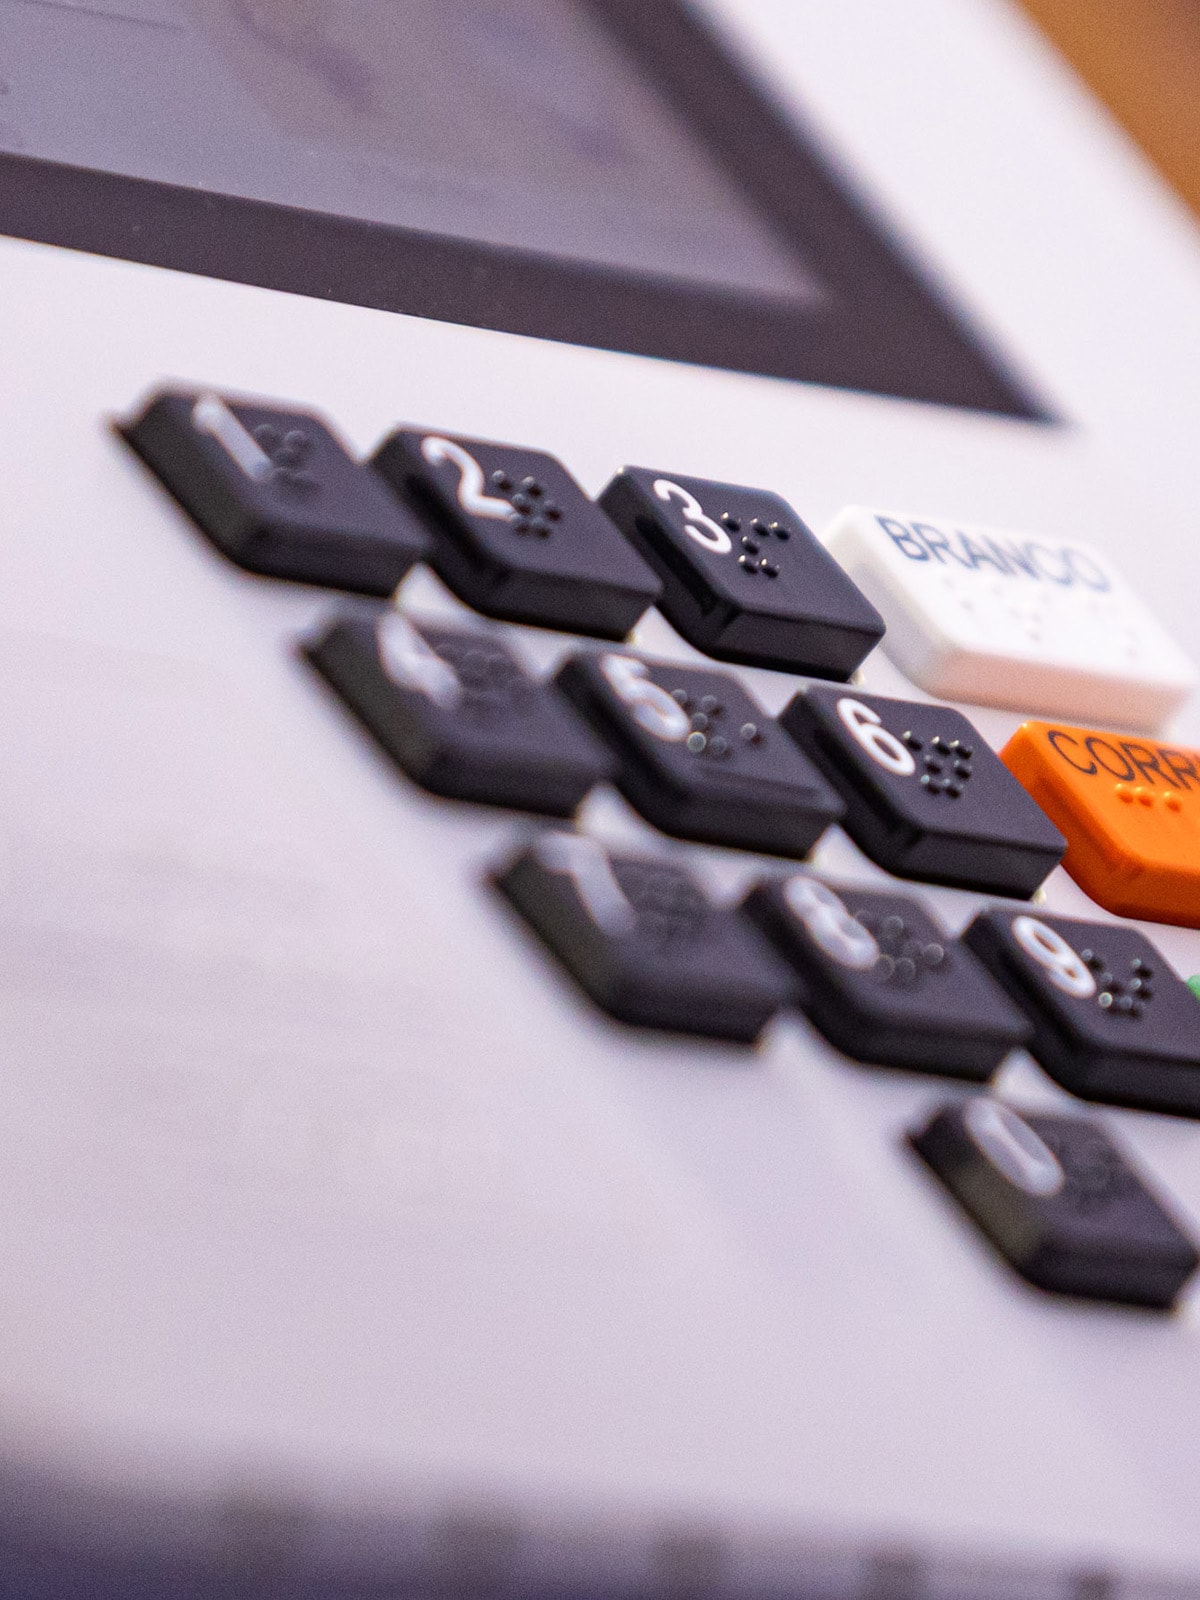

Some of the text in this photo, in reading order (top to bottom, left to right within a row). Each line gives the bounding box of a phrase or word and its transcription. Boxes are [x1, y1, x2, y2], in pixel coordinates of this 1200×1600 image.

[421, 436, 520, 523] 2
[653, 479, 733, 554] 3
[873, 514, 1112, 593] BRANCO
[602, 653, 691, 742] 5
[837, 697, 916, 777] 6
[785, 874, 880, 969] 8
[1011, 915, 1097, 999] 9
[963, 1099, 1066, 1197] 0
